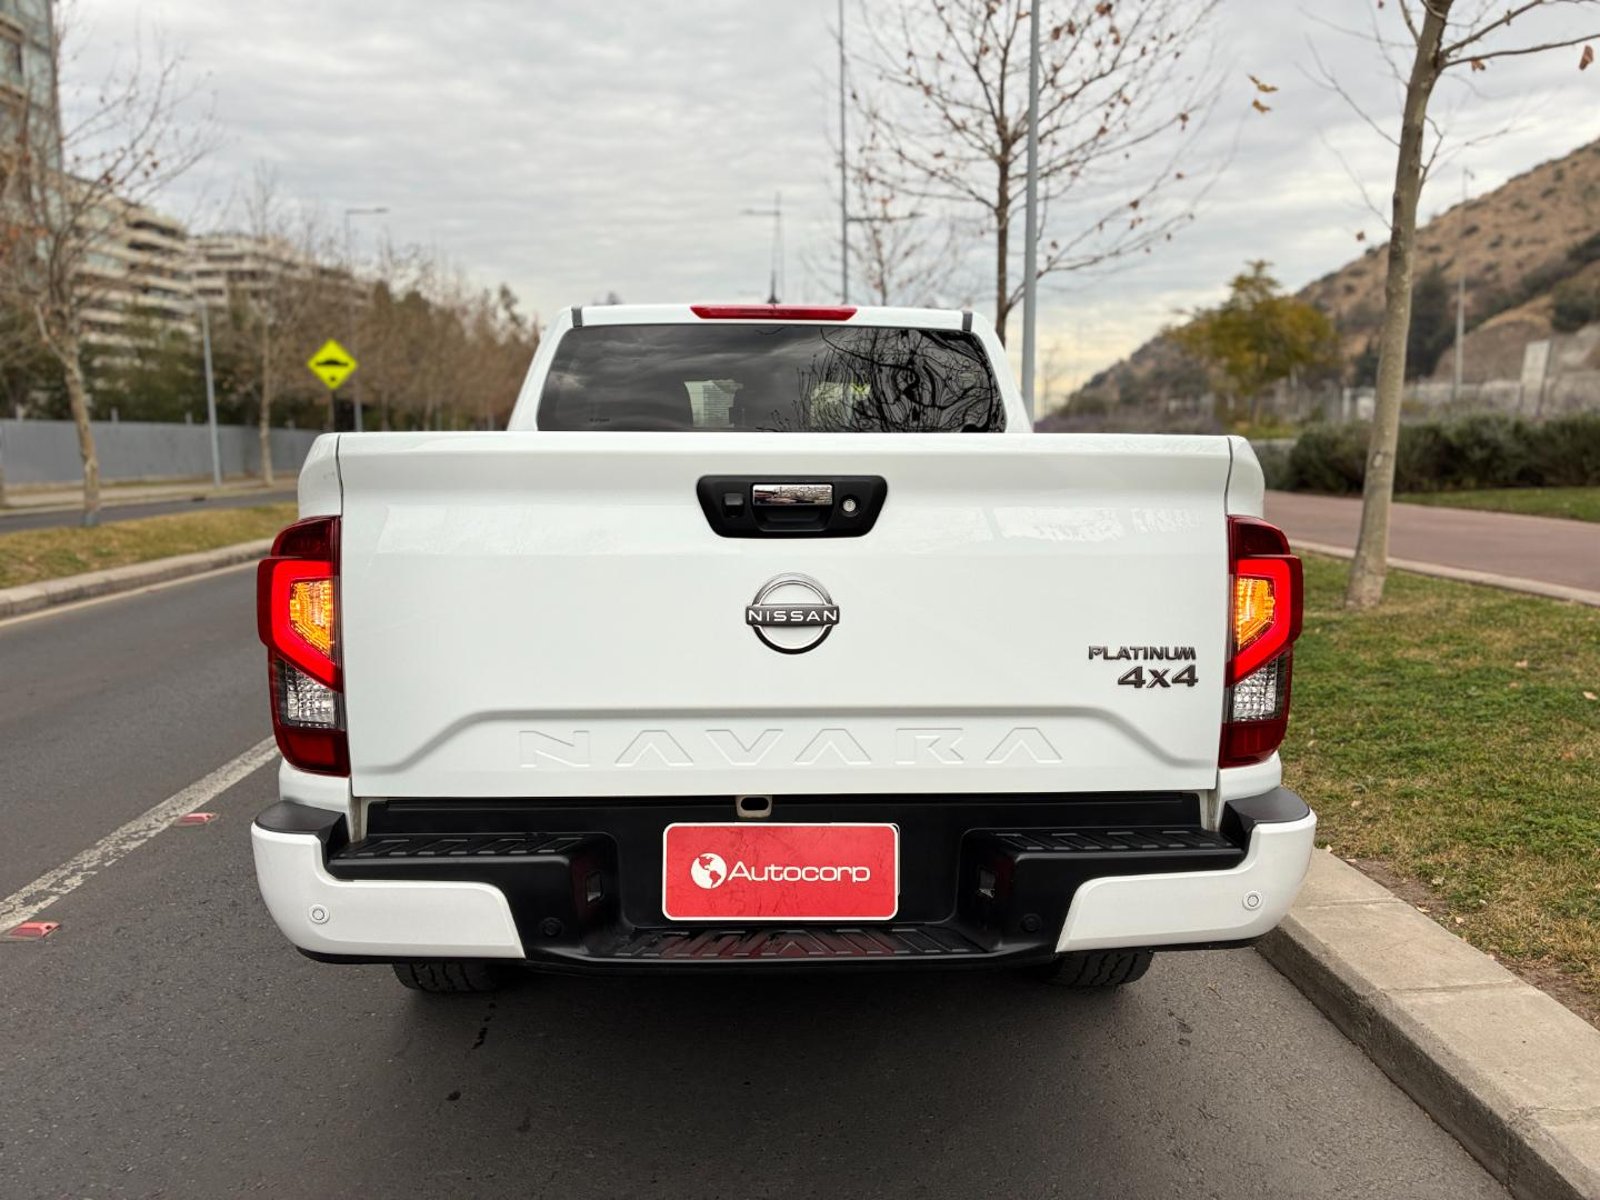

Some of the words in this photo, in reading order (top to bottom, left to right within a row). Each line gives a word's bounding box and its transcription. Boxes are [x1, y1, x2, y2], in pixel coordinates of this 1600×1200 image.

[748, 609, 837, 622] NISSAN
[1088, 645, 1197, 660] PLATINUM
[519, 728, 1063, 768] NAVARA
[727, 861, 871, 883] Autocorp
